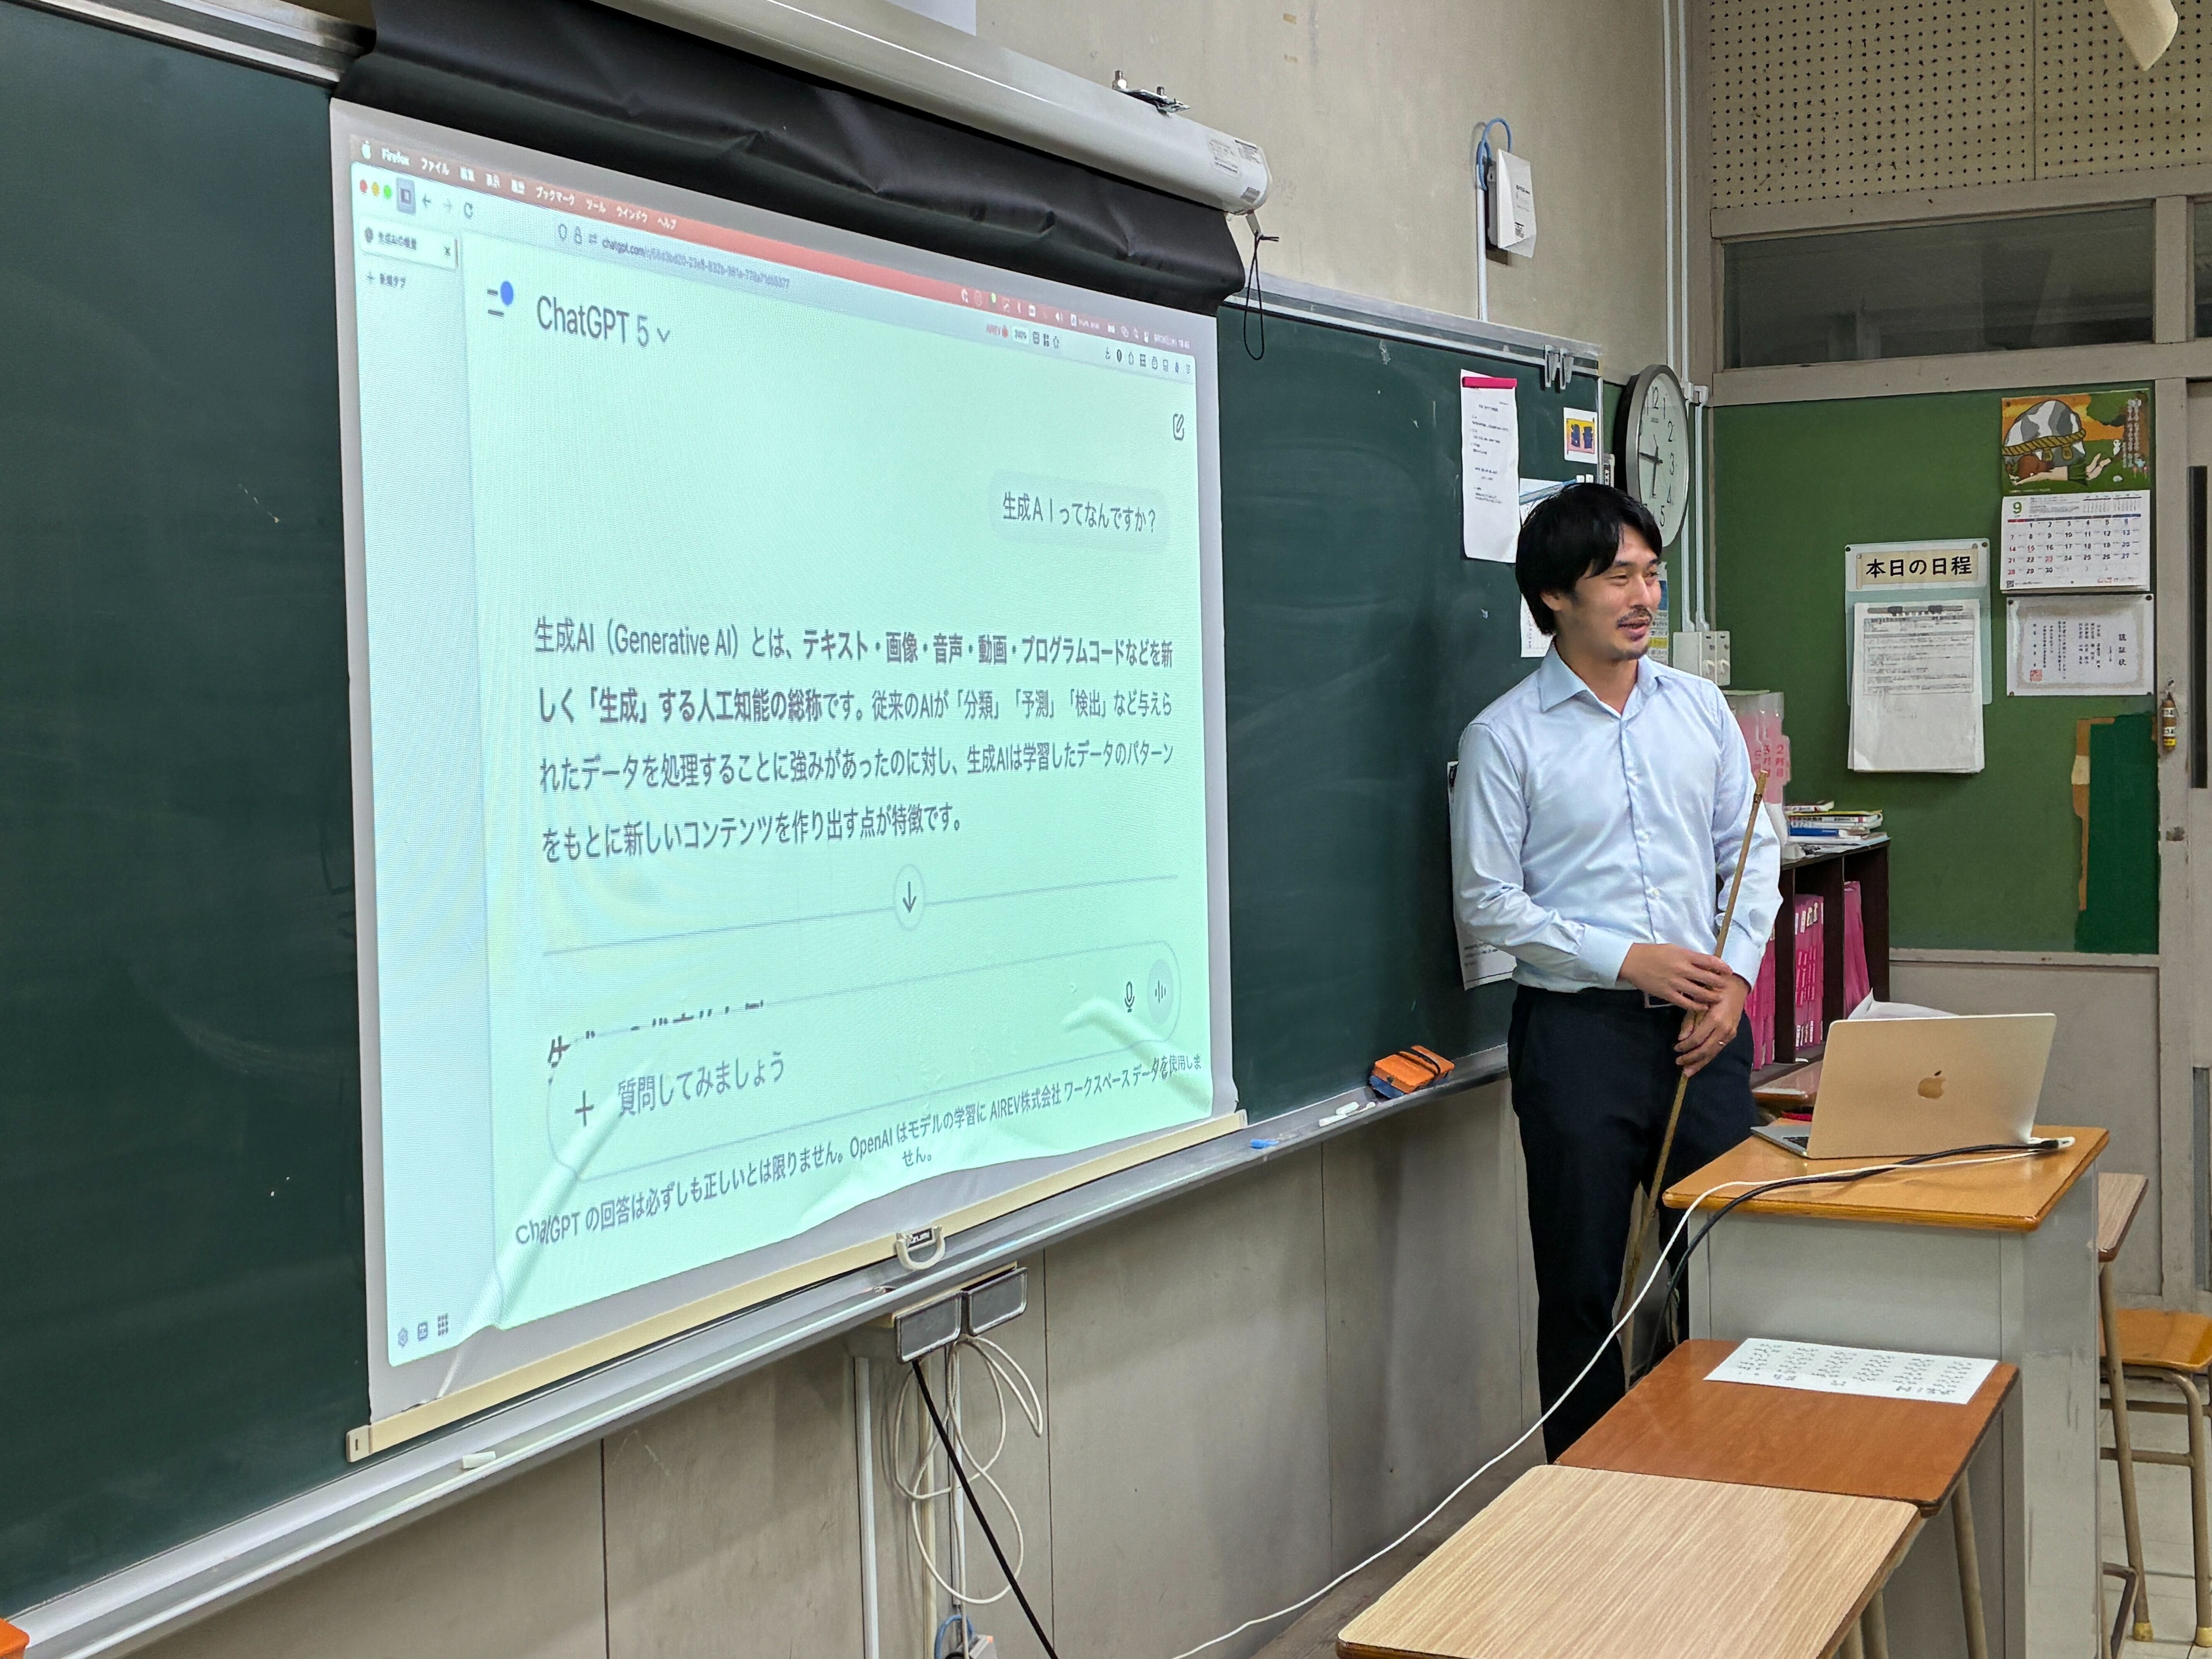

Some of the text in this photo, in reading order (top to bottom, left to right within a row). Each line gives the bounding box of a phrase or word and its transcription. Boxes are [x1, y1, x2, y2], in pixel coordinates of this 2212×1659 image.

[537, 295, 649, 347] ChatGPT 5
[1668, 420, 1673, 442] 2
[1669, 452, 1674, 476] 3
[1660, 505, 1665, 527] 5
[2013, 501, 2022, 514] 9
[1866, 556, 1973, 578] 本日の日程
[618, 1051, 783, 1118] 質問してみましょう
[902, 1147, 932, 1167] せん。
[516, 1212, 580, 1245] ChatGPT
